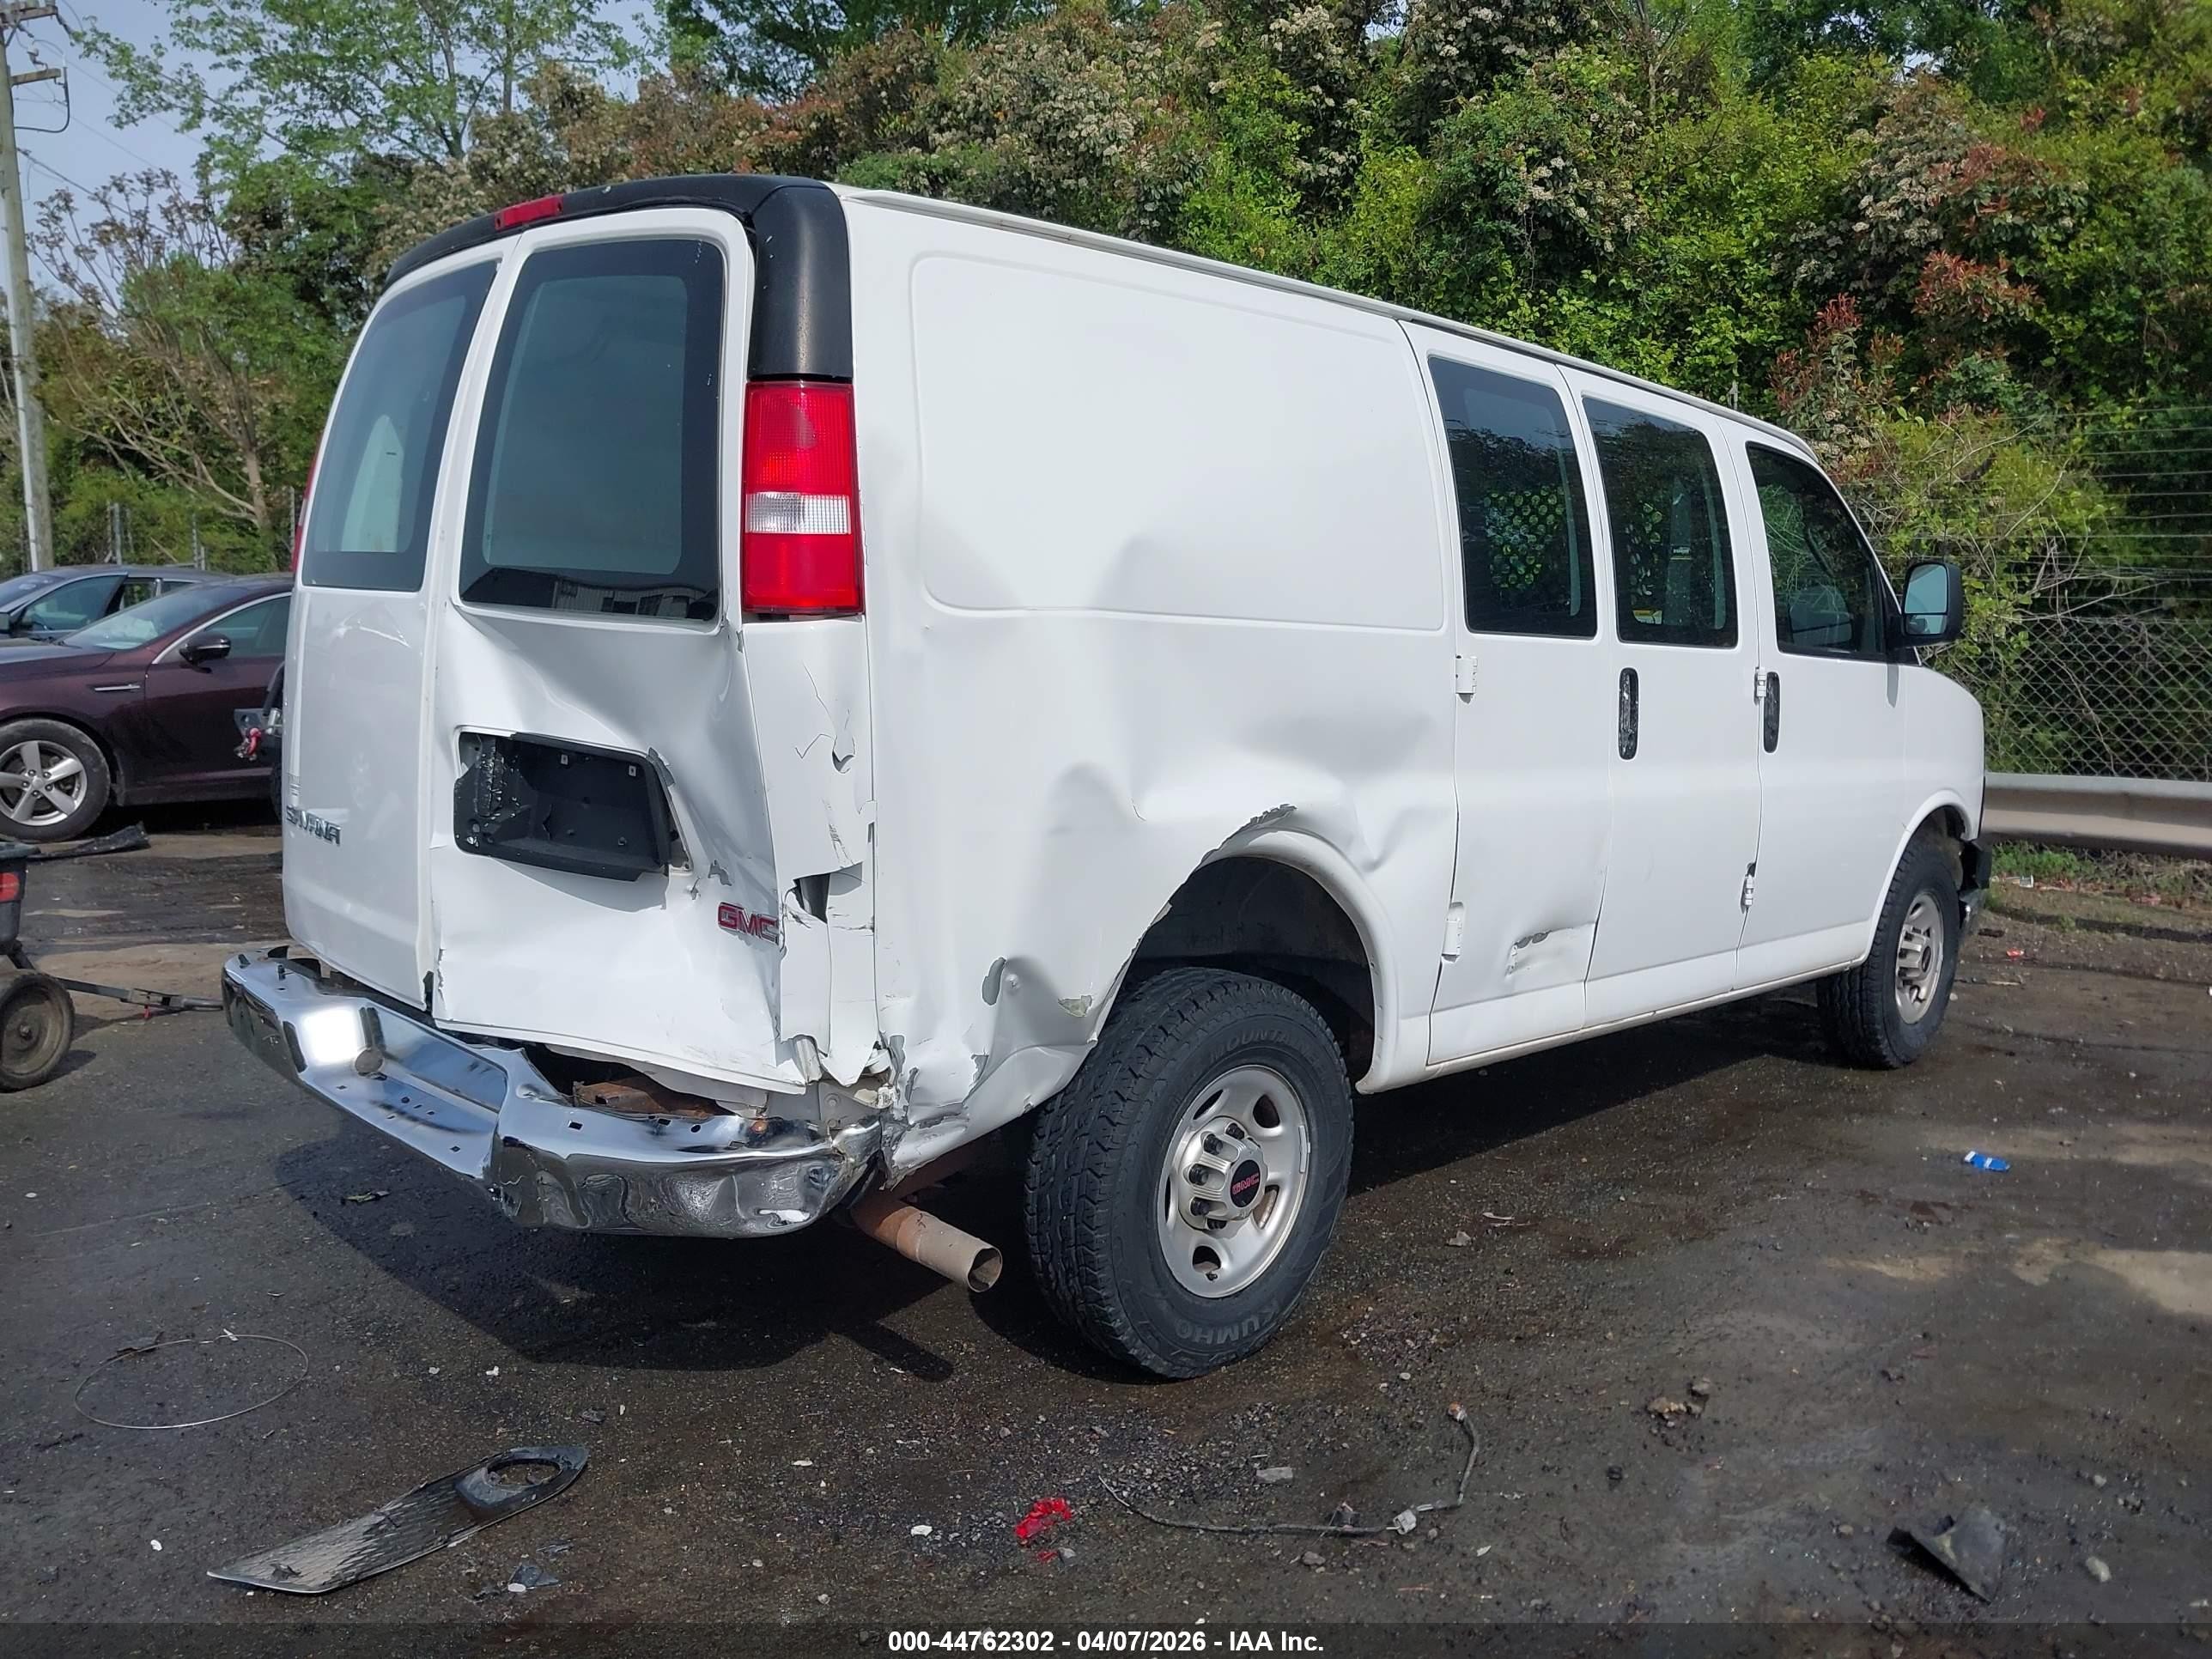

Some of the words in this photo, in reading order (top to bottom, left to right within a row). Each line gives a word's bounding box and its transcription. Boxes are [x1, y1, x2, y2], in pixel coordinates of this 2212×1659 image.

[718, 901, 780, 946] GMC
[1231, 1172, 1260, 1195] GMC
[1175, 1309, 1278, 1345] KUMHO
